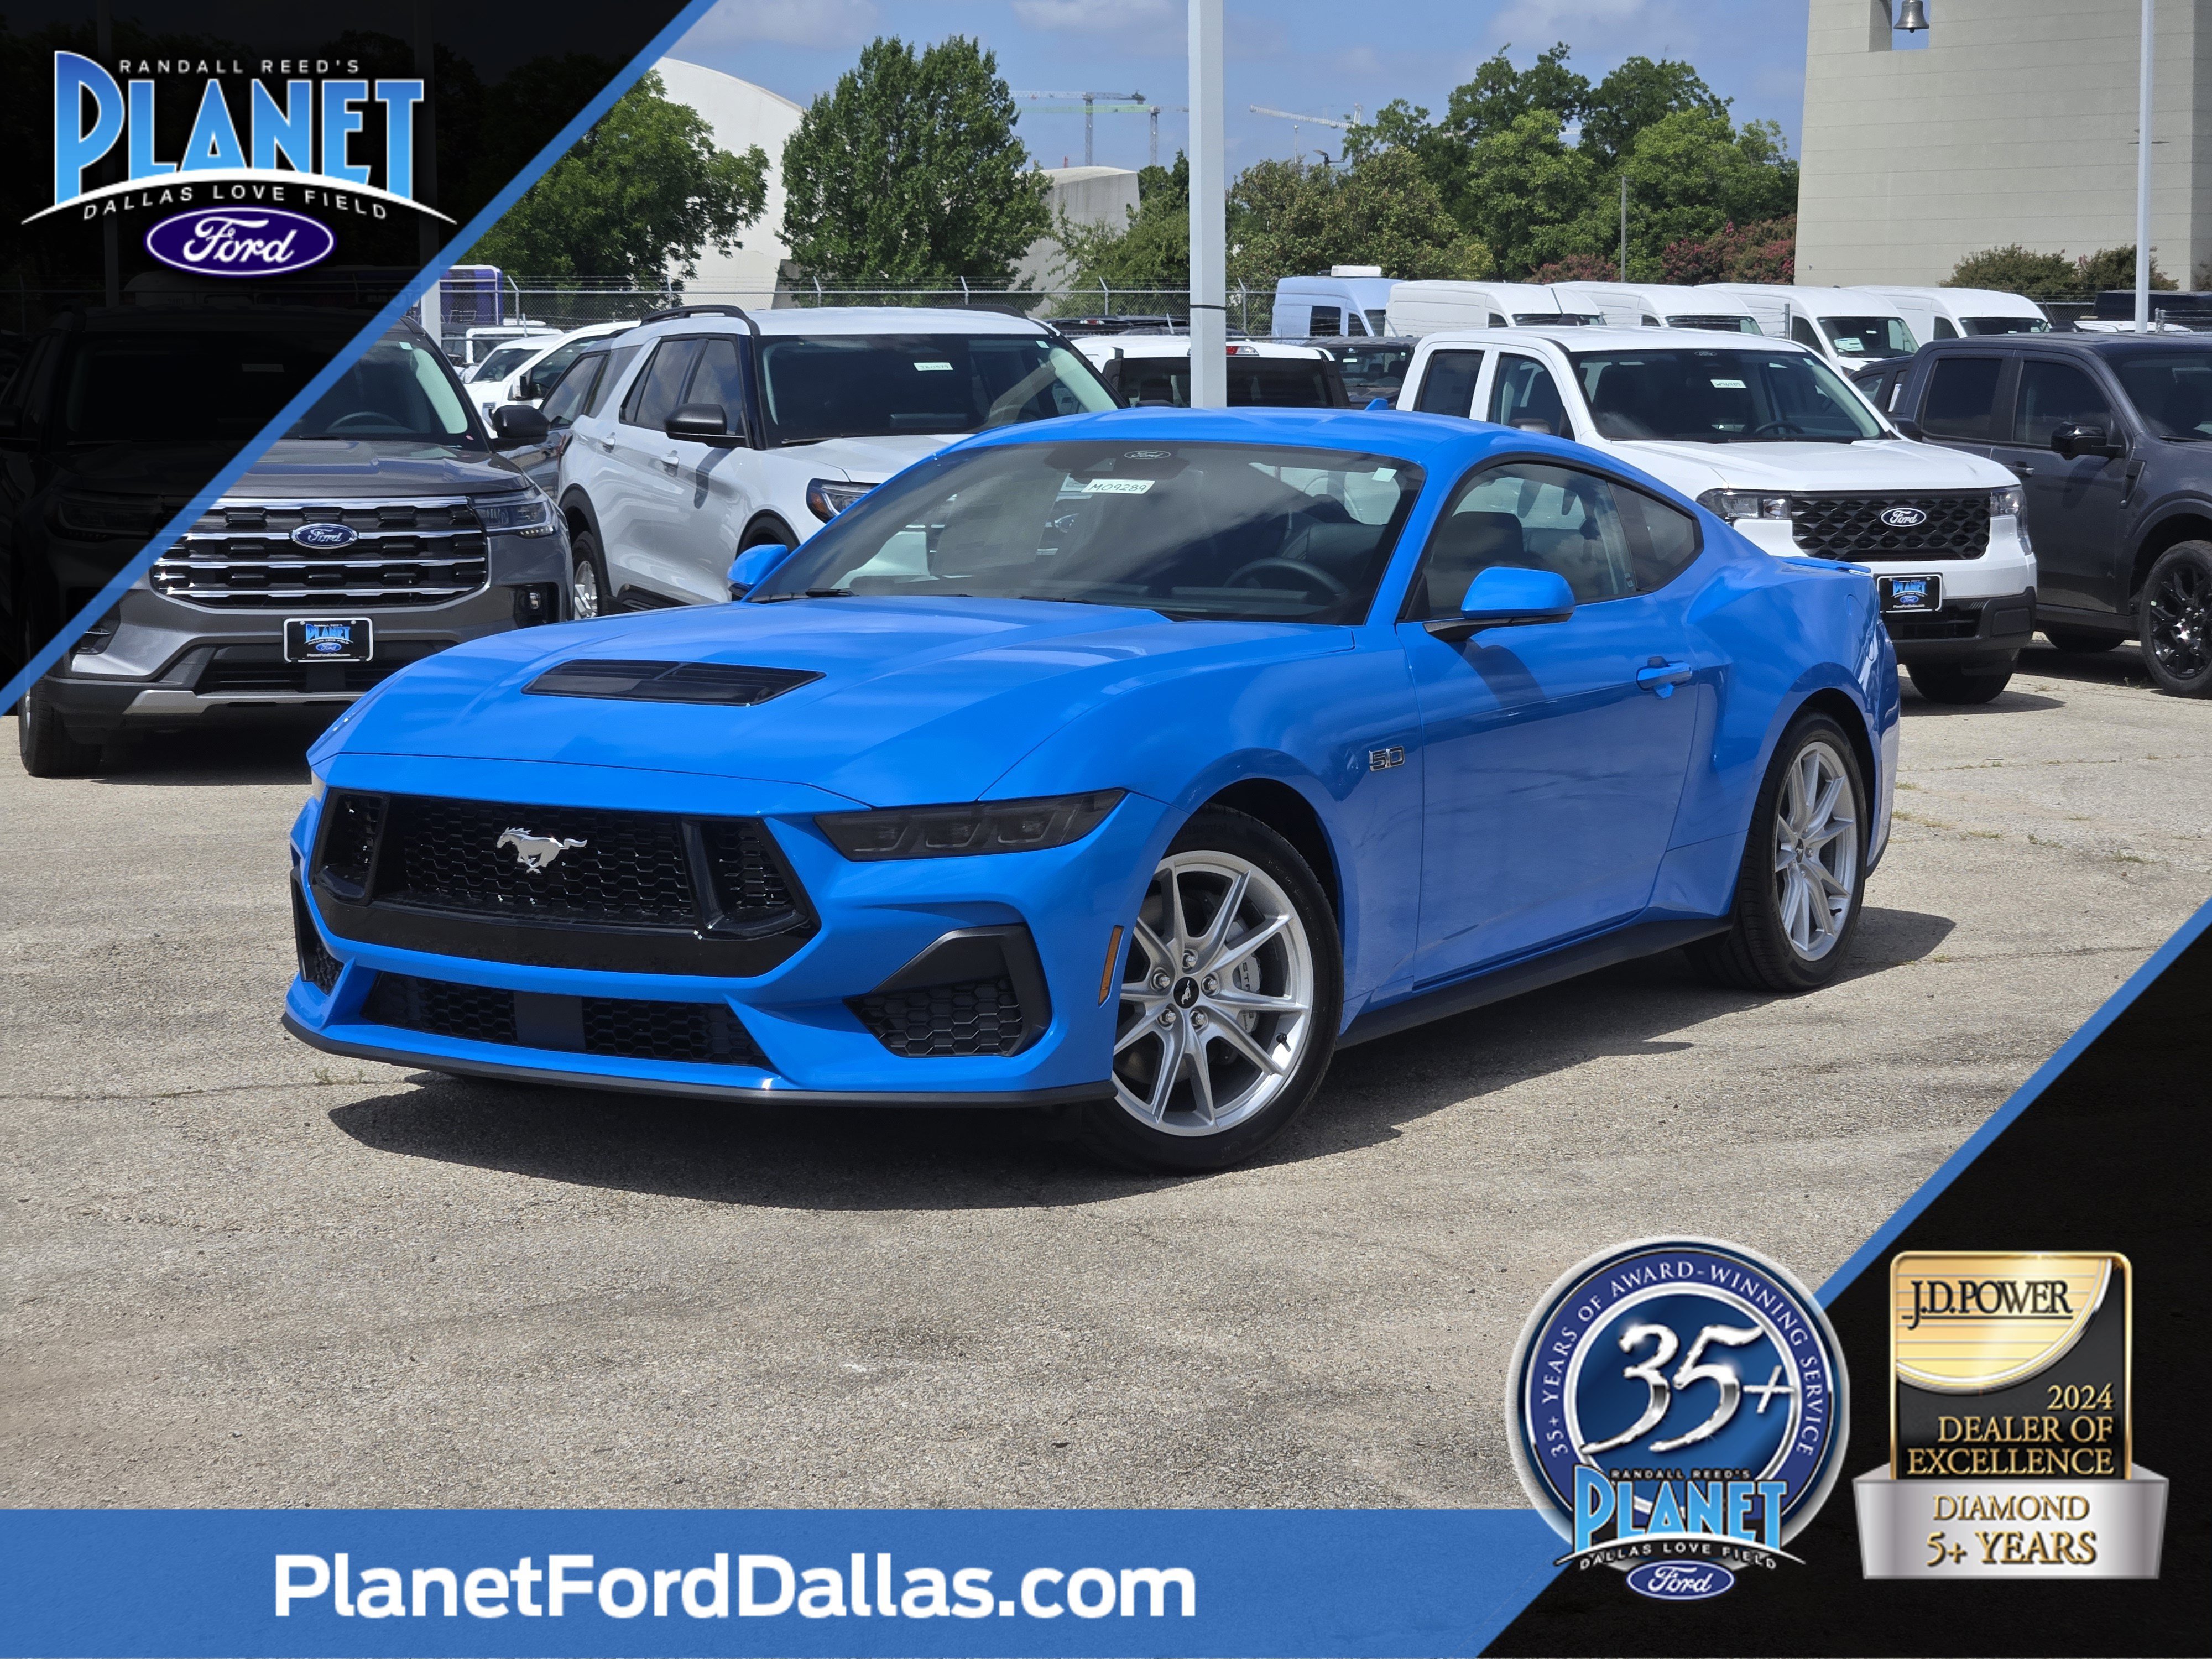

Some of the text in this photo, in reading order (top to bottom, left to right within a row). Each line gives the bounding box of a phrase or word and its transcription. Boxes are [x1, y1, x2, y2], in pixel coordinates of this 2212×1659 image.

[1088, 483, 1147, 492] M09289
[1889, 510, 1918, 524] Ford
[308, 528, 342, 542] Ford
[306, 623, 351, 643] PLANET
